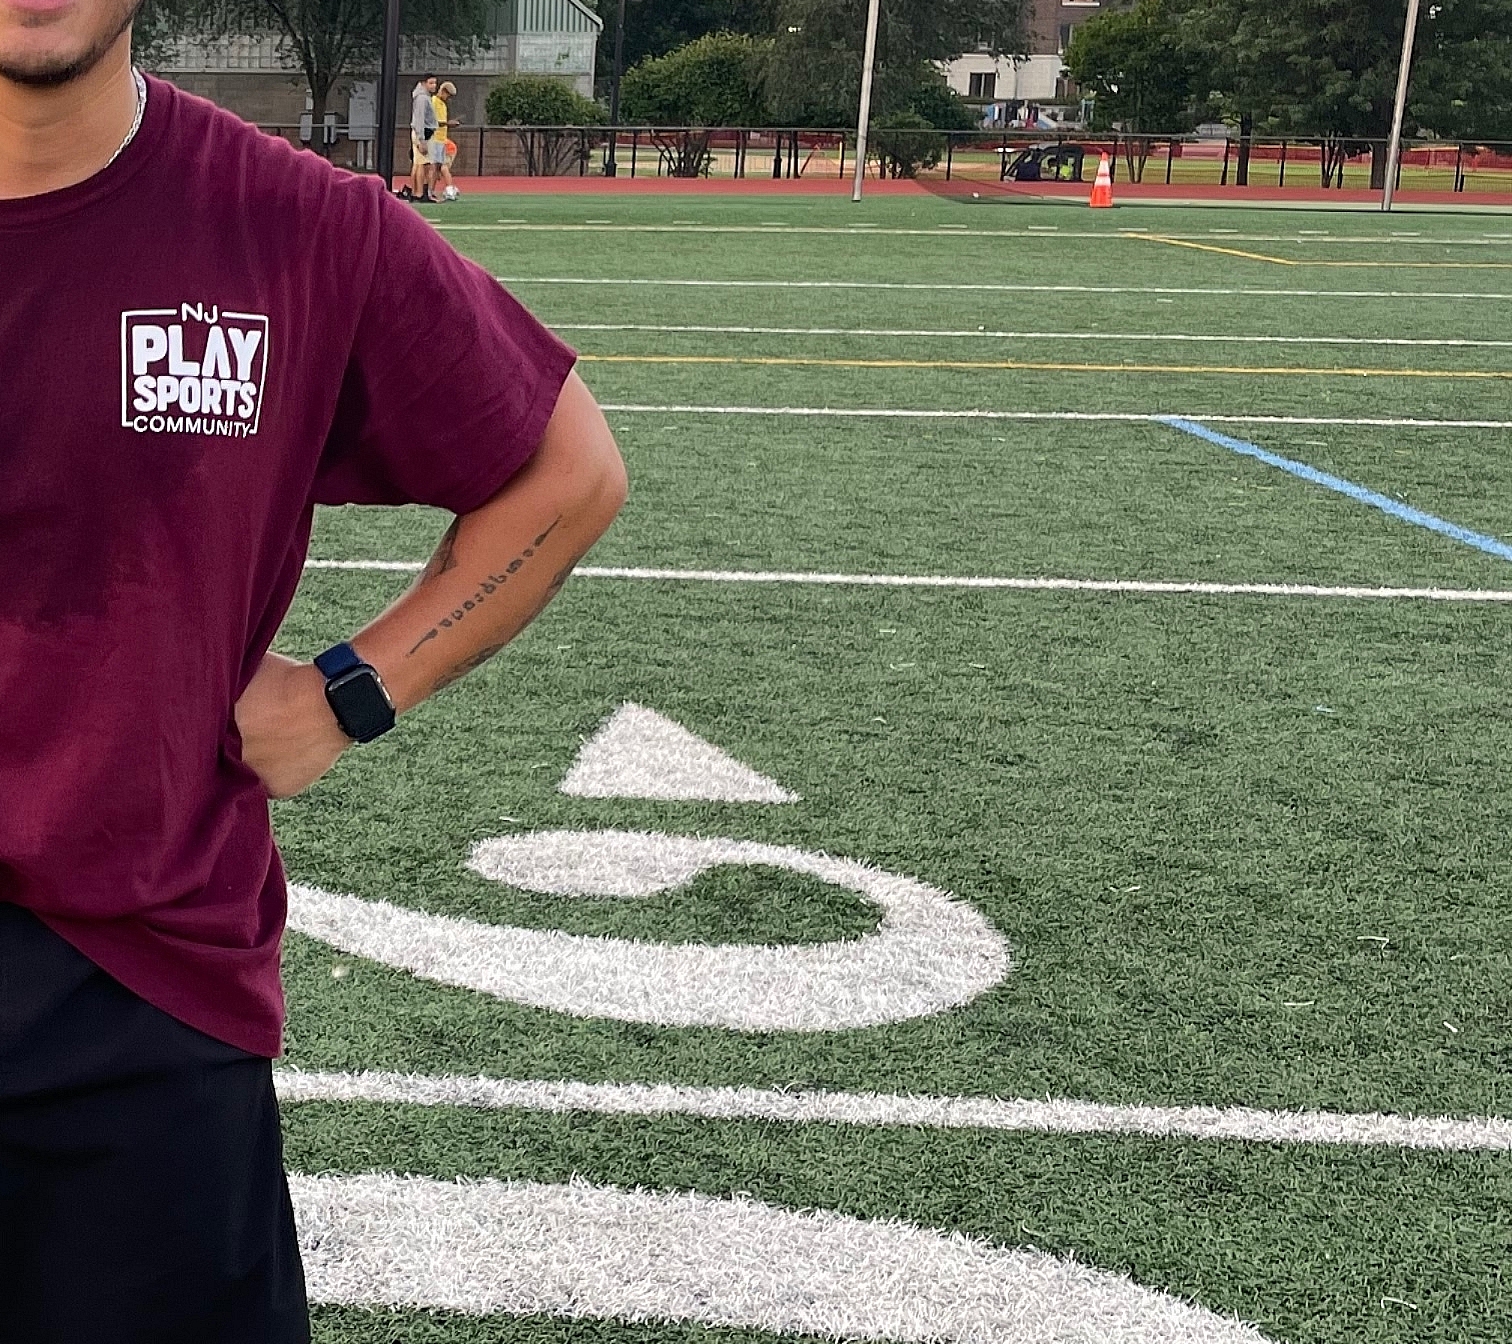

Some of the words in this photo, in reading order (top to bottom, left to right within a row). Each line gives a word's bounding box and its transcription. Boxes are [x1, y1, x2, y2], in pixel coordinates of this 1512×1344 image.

[181, 302, 218, 324] NJ
[132, 325, 262, 381] PLAY
[133, 375, 257, 419] SPORTS
[133, 415, 251, 438] COMMUNITY
